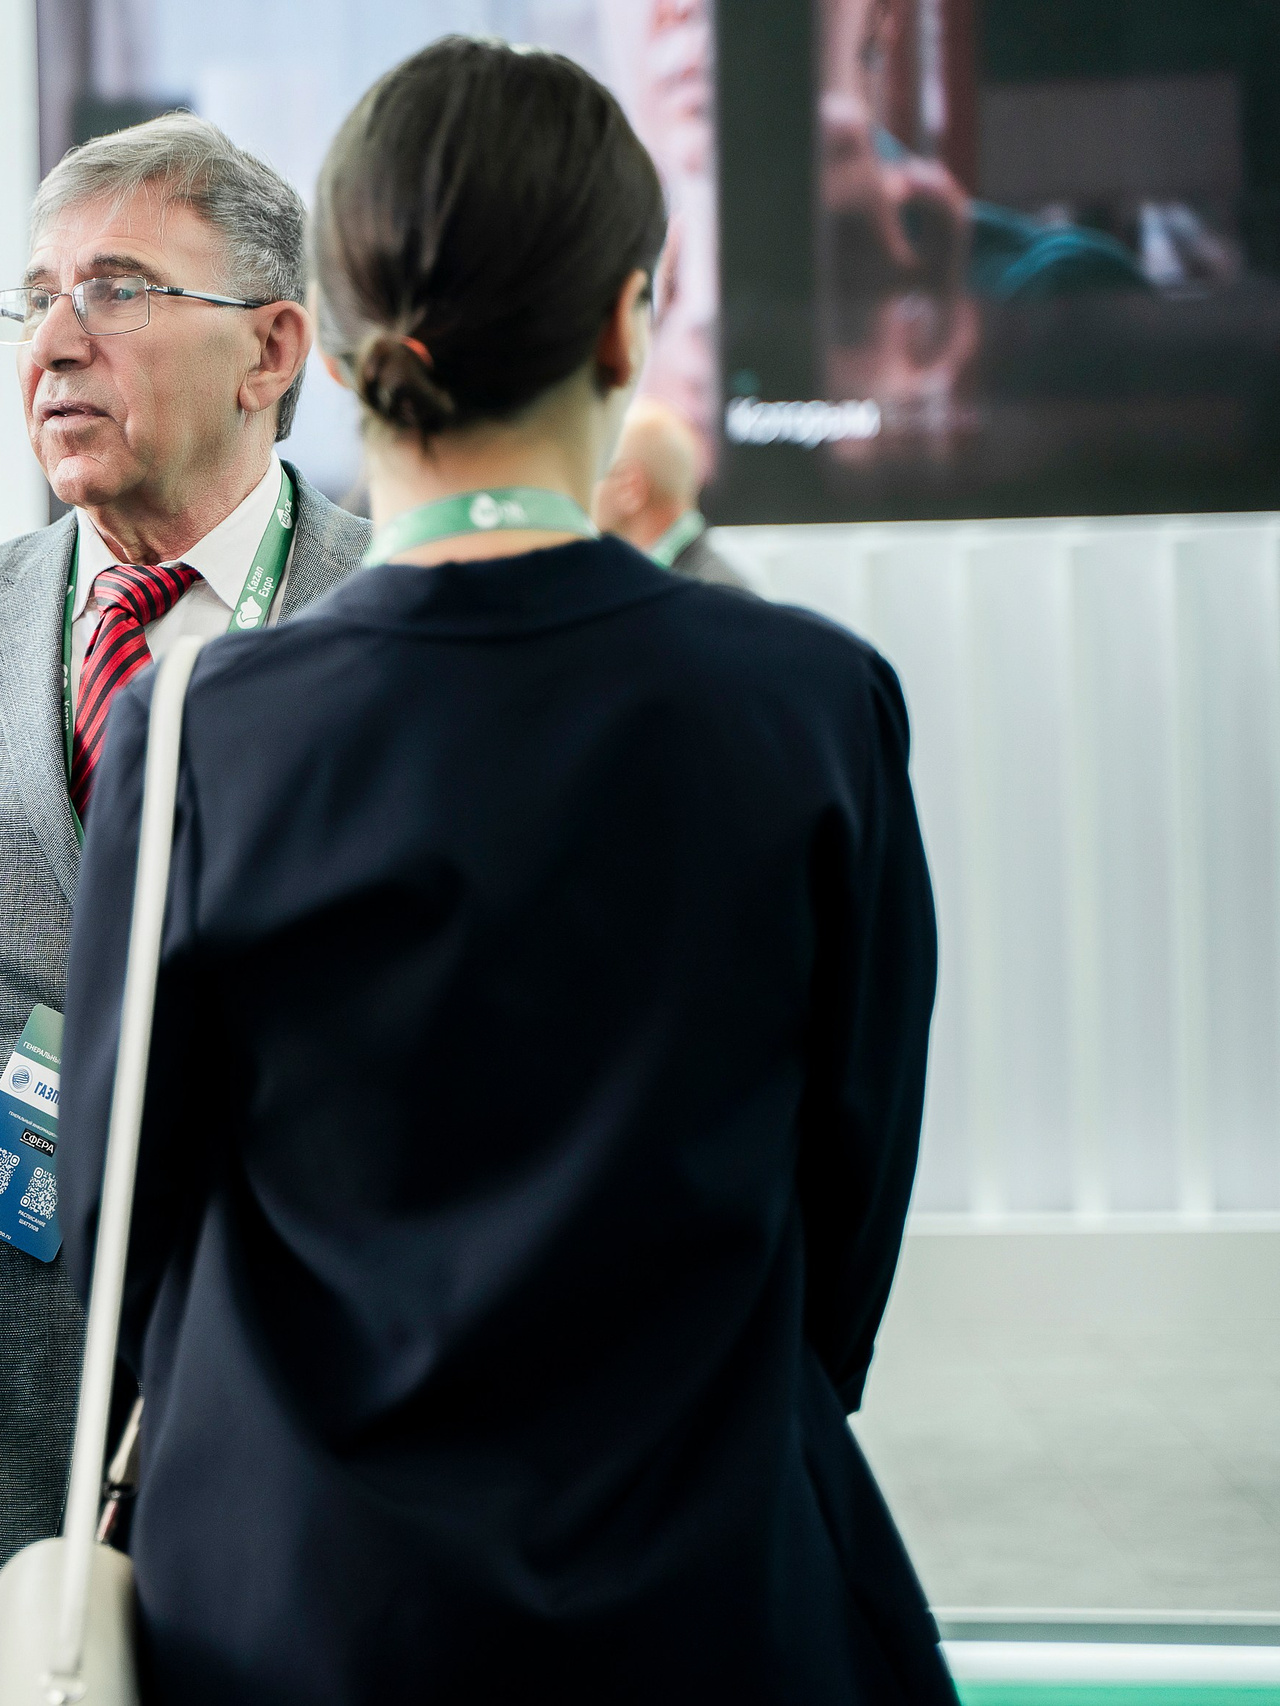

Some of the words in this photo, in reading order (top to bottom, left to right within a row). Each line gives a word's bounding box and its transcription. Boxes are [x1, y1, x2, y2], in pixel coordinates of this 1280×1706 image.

[246, 566, 264, 592] Kazan
[258, 576, 274, 598] Expo
[23, 1041, 61, 1065] ГЕНЕРАЛЬНЫ
[34, 1081, 60, 1105] ГАЗП
[22, 1131, 55, 1154] СФЕРА
[18, 1209, 46, 1228] РАСПИСАНИЕ
[18, 1218, 40, 1233] ШАТТЛОВ
